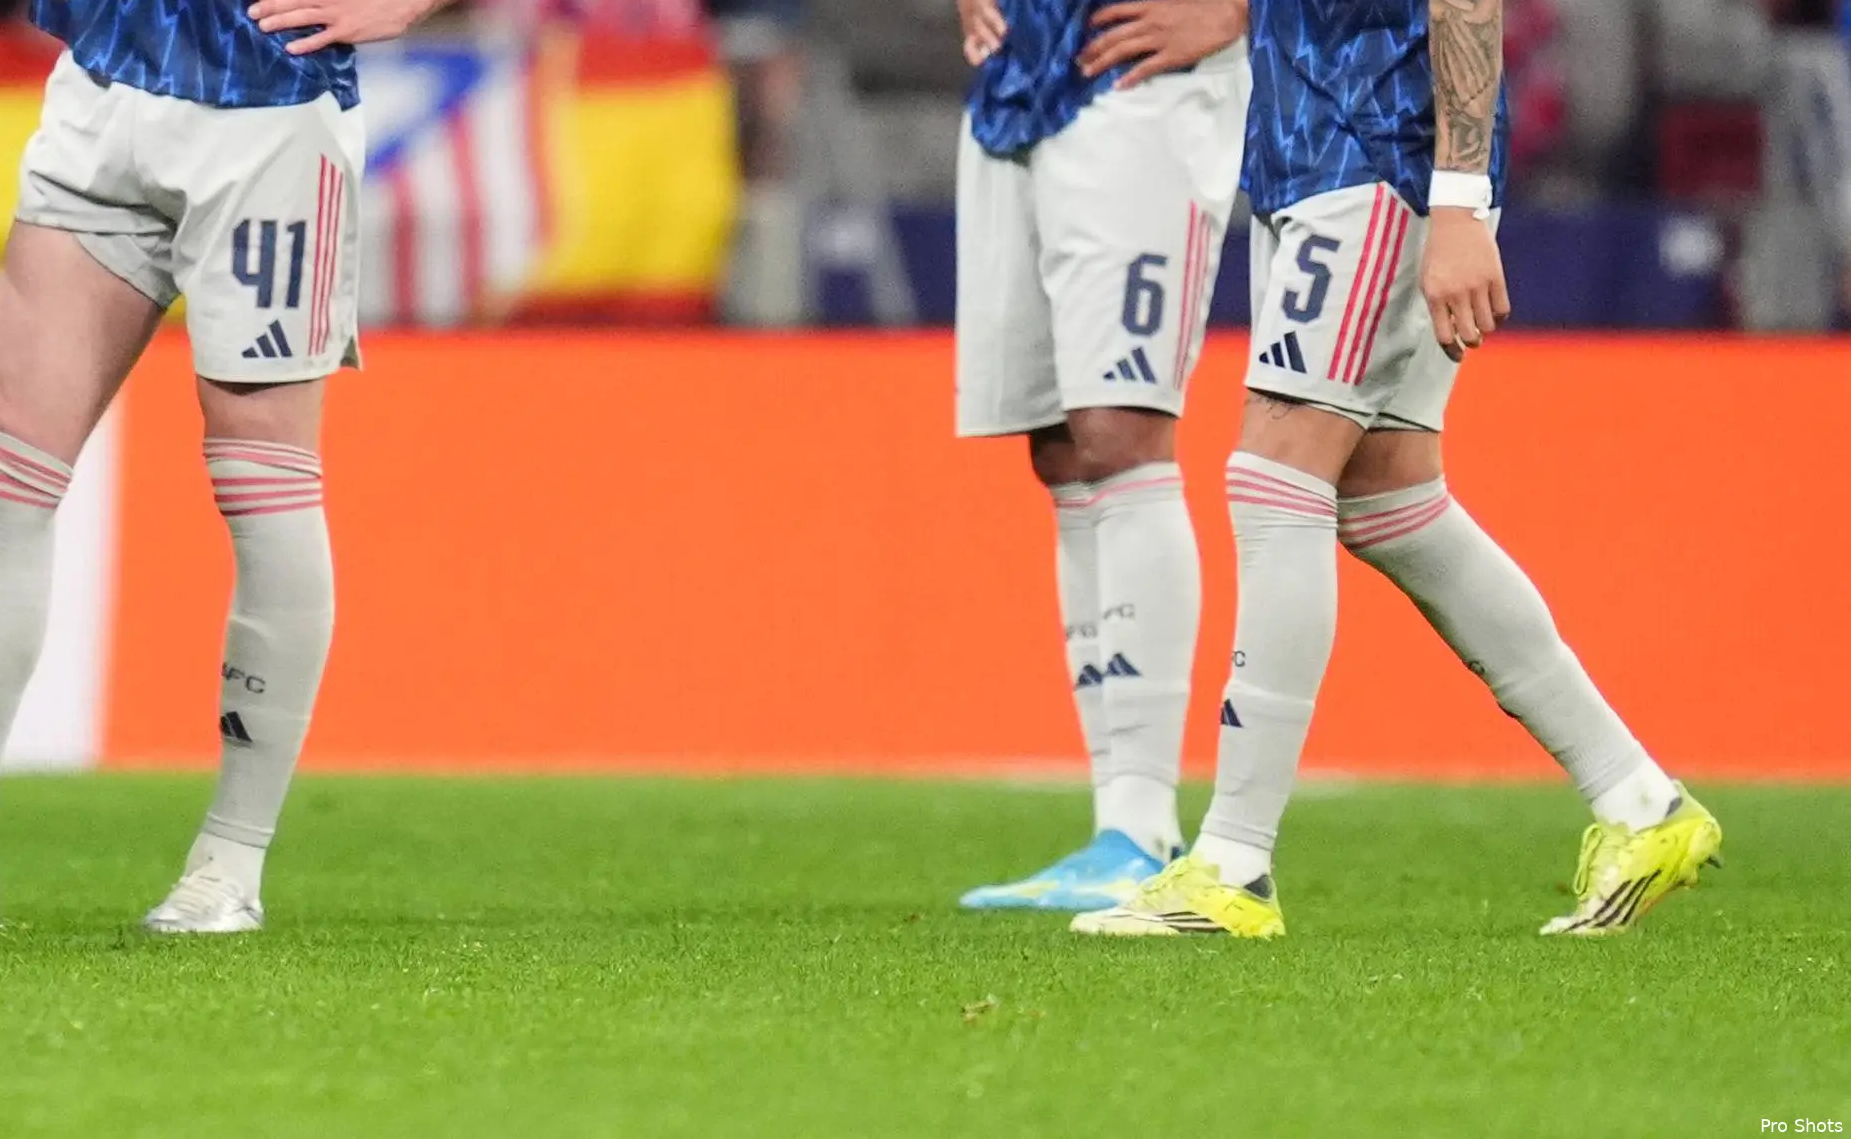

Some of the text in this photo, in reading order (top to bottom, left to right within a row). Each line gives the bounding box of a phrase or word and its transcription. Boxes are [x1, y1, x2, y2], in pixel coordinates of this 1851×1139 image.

[231, 219, 307, 308] 41
[1121, 252, 1169, 336] 6
[1282, 233, 1341, 323] 5
